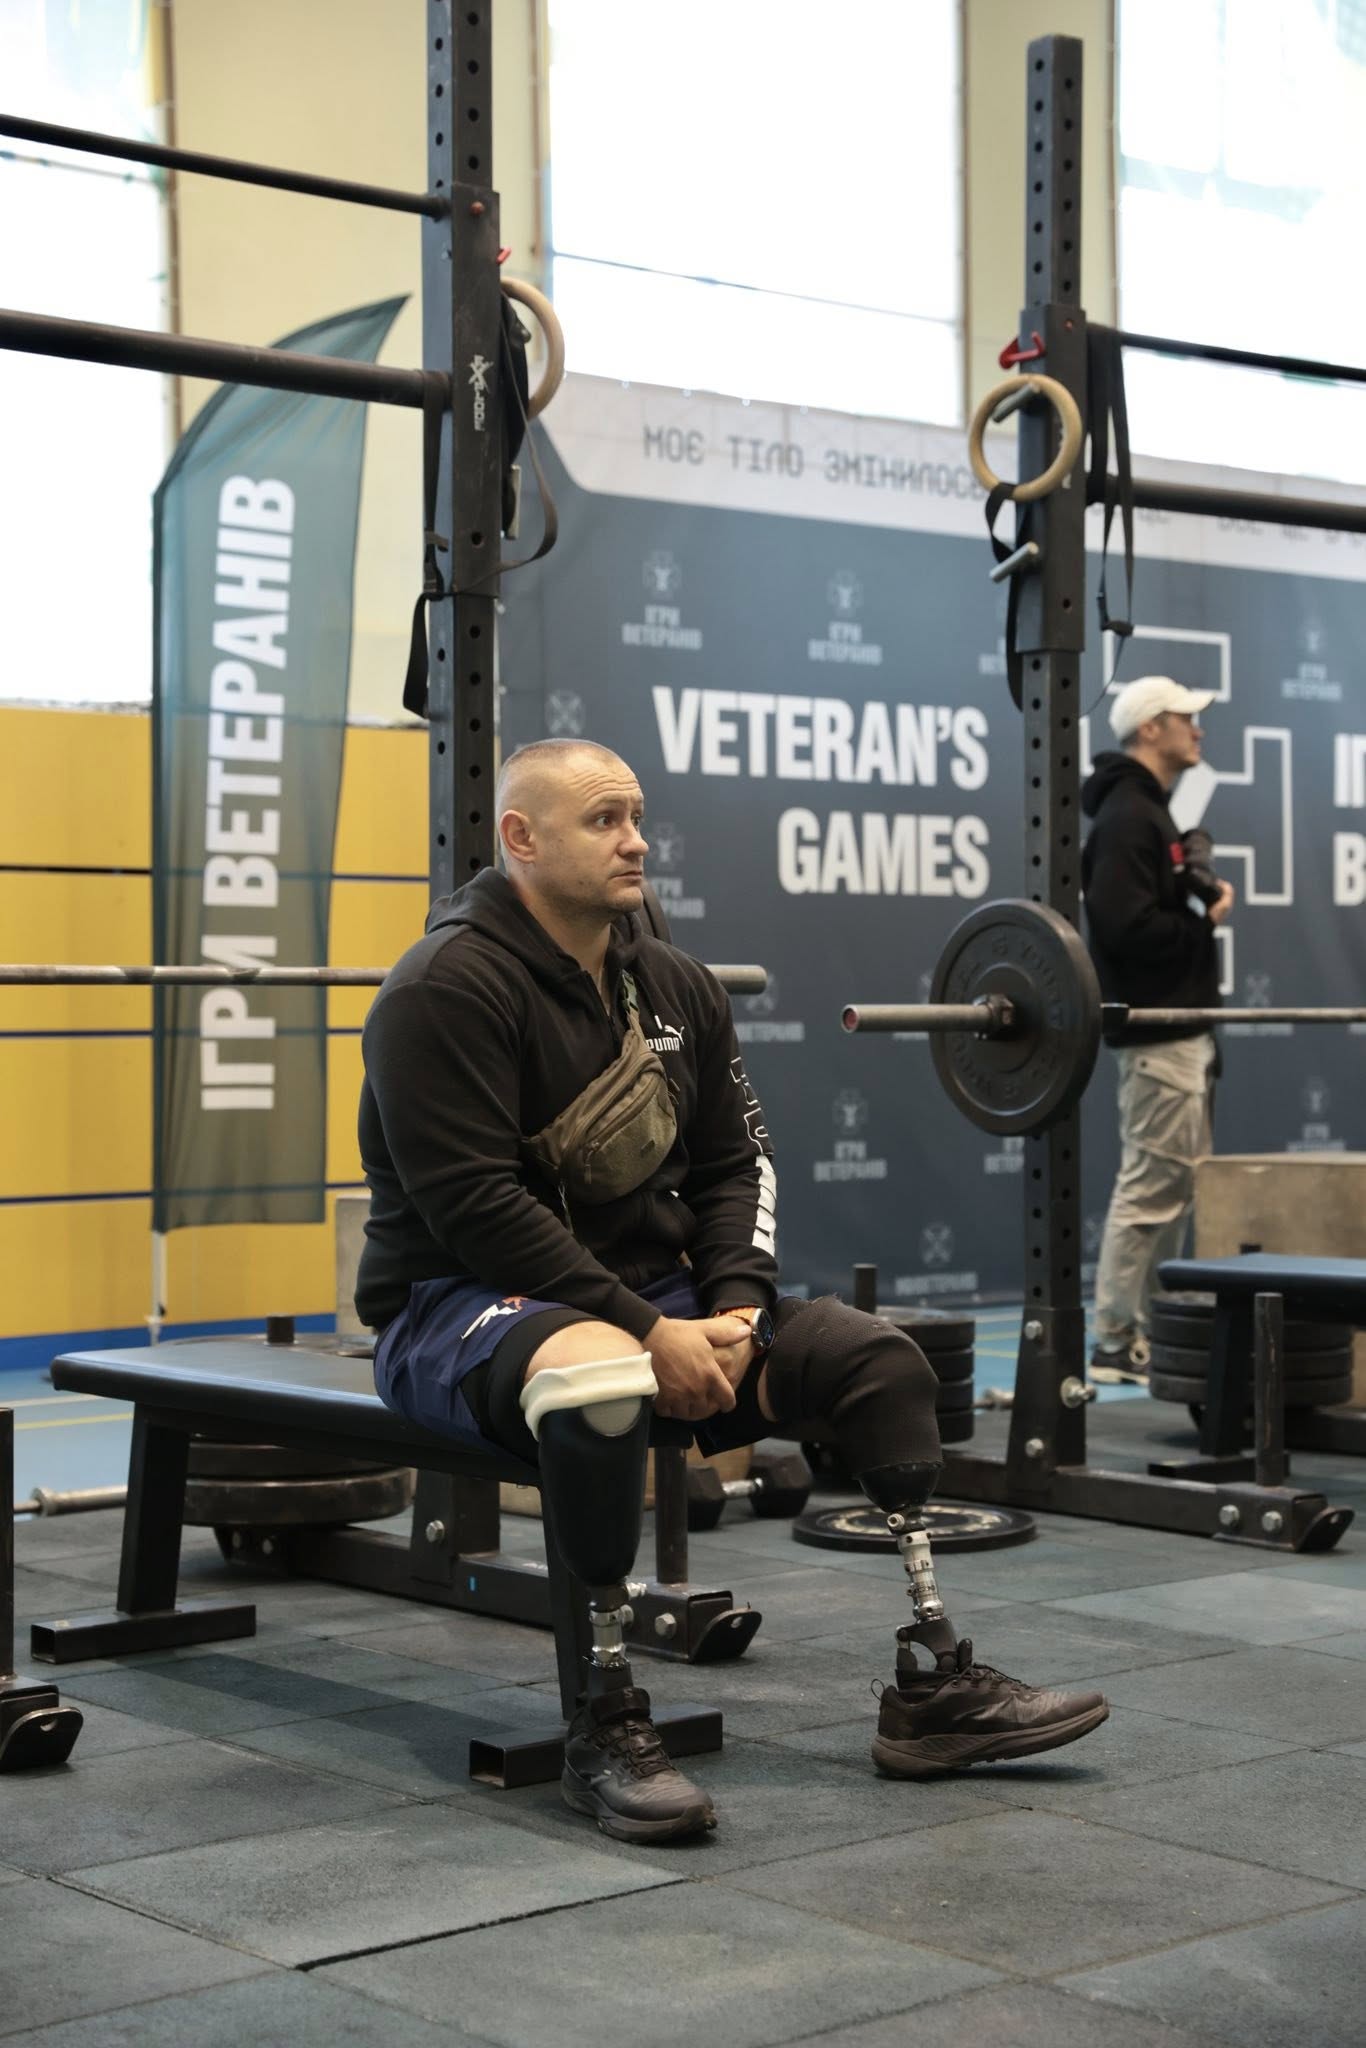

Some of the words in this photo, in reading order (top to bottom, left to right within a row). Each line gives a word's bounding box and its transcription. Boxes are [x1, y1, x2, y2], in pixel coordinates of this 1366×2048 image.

[203, 475, 295, 907] ВЕТЕРАНІВ
[652, 686, 990, 791] VETERAN'S
[777, 807, 990, 899] GAMES
[645, 1037, 680, 1051] PUMA
